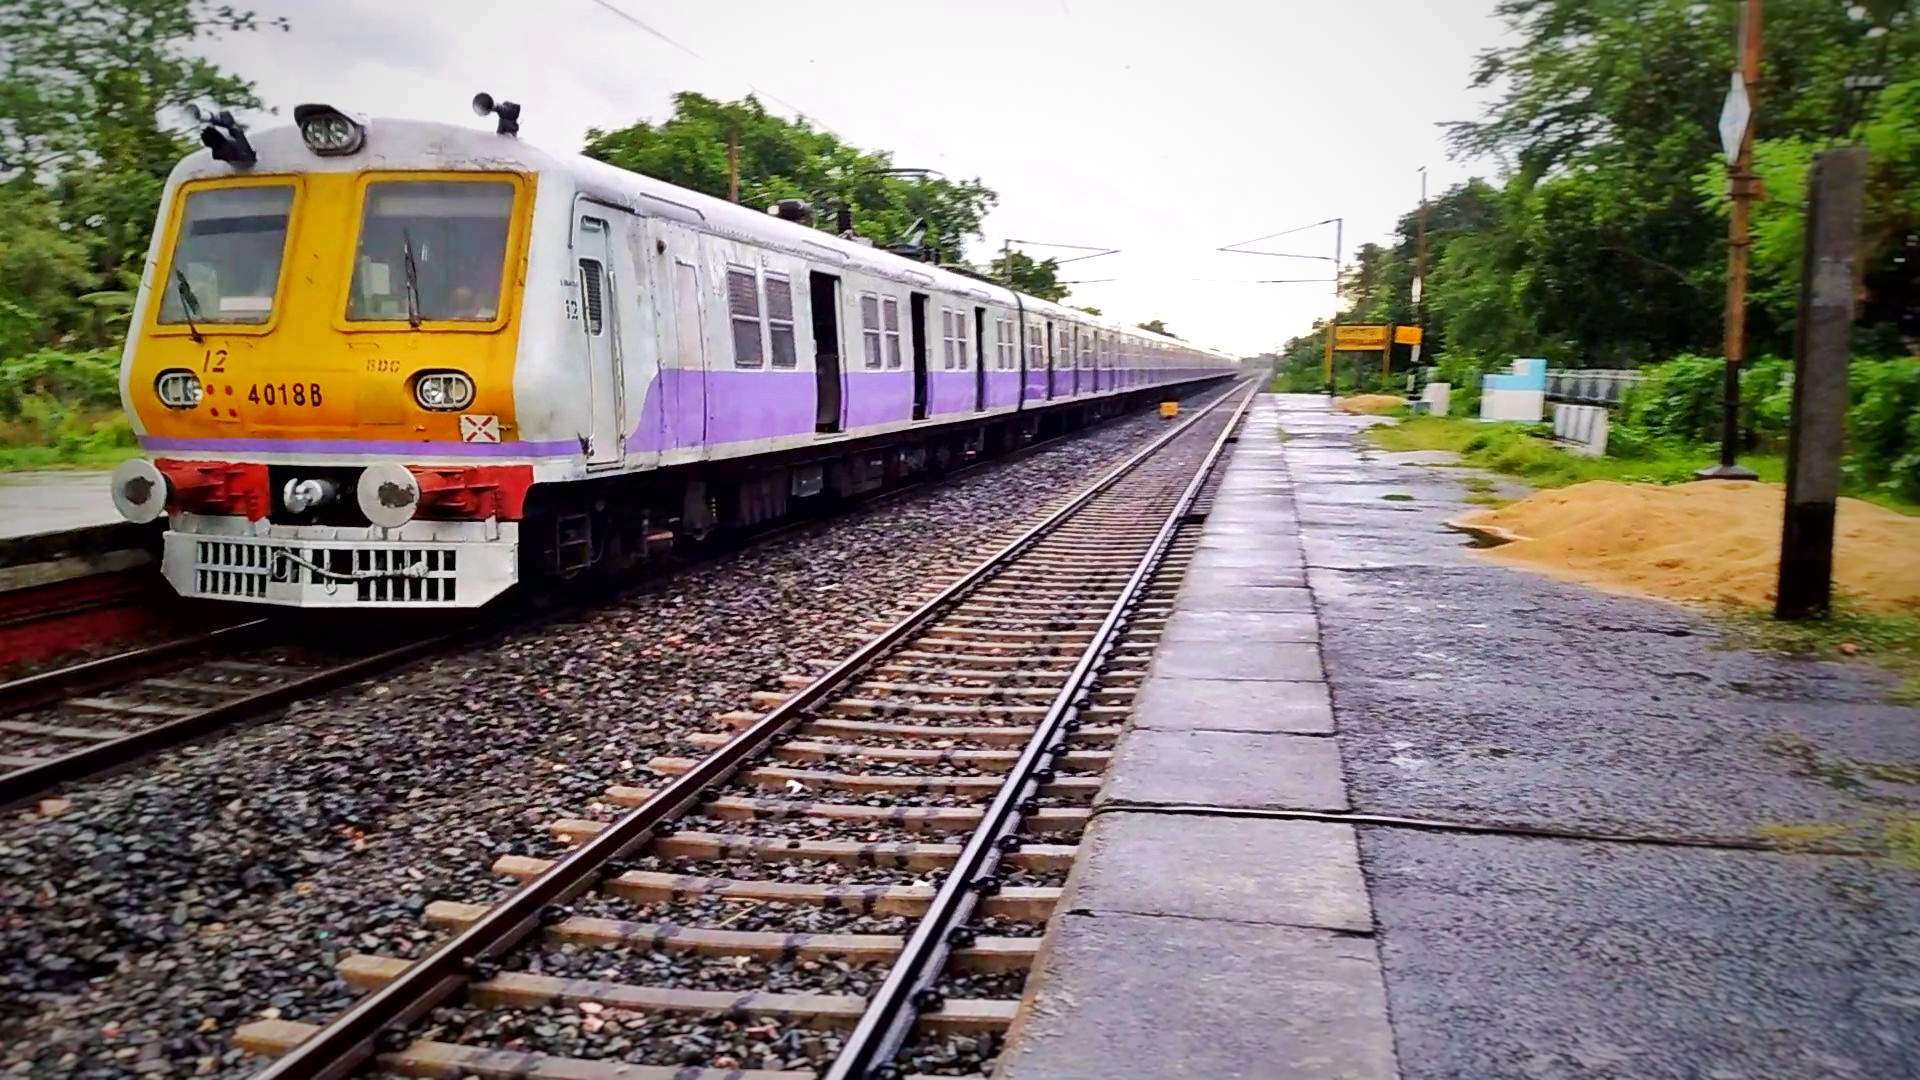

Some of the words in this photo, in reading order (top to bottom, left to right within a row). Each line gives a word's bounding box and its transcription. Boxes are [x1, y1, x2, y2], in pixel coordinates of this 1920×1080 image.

[565, 299, 578, 320] 12
[203, 350, 228, 373] 12
[248, 383, 322, 407] 4018B
